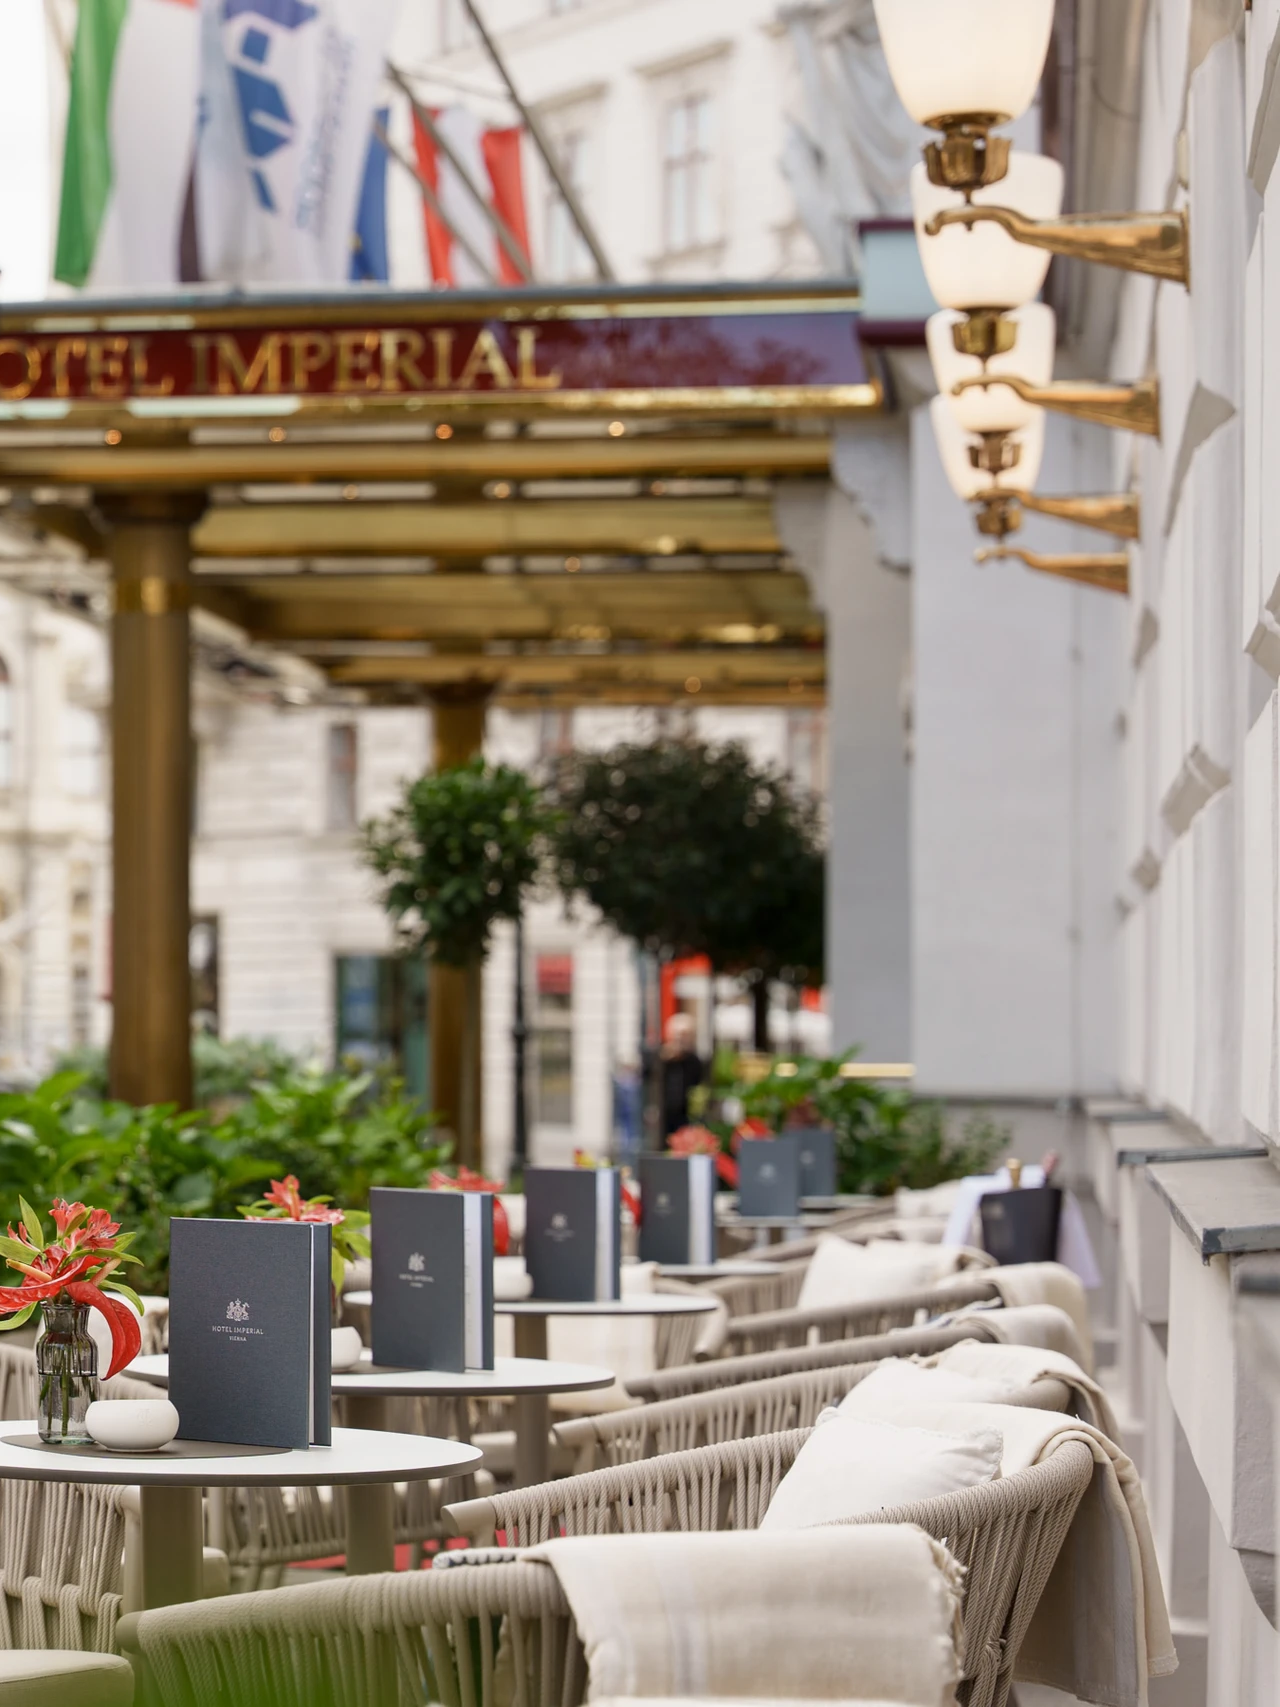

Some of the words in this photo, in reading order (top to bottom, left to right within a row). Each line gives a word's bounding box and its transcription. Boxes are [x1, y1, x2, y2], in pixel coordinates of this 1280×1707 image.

[189, 328, 563, 397] IMPERIAL
[212, 1325, 232, 1333] HOTEL
[233, 1327, 264, 1335] IMPERIAL
